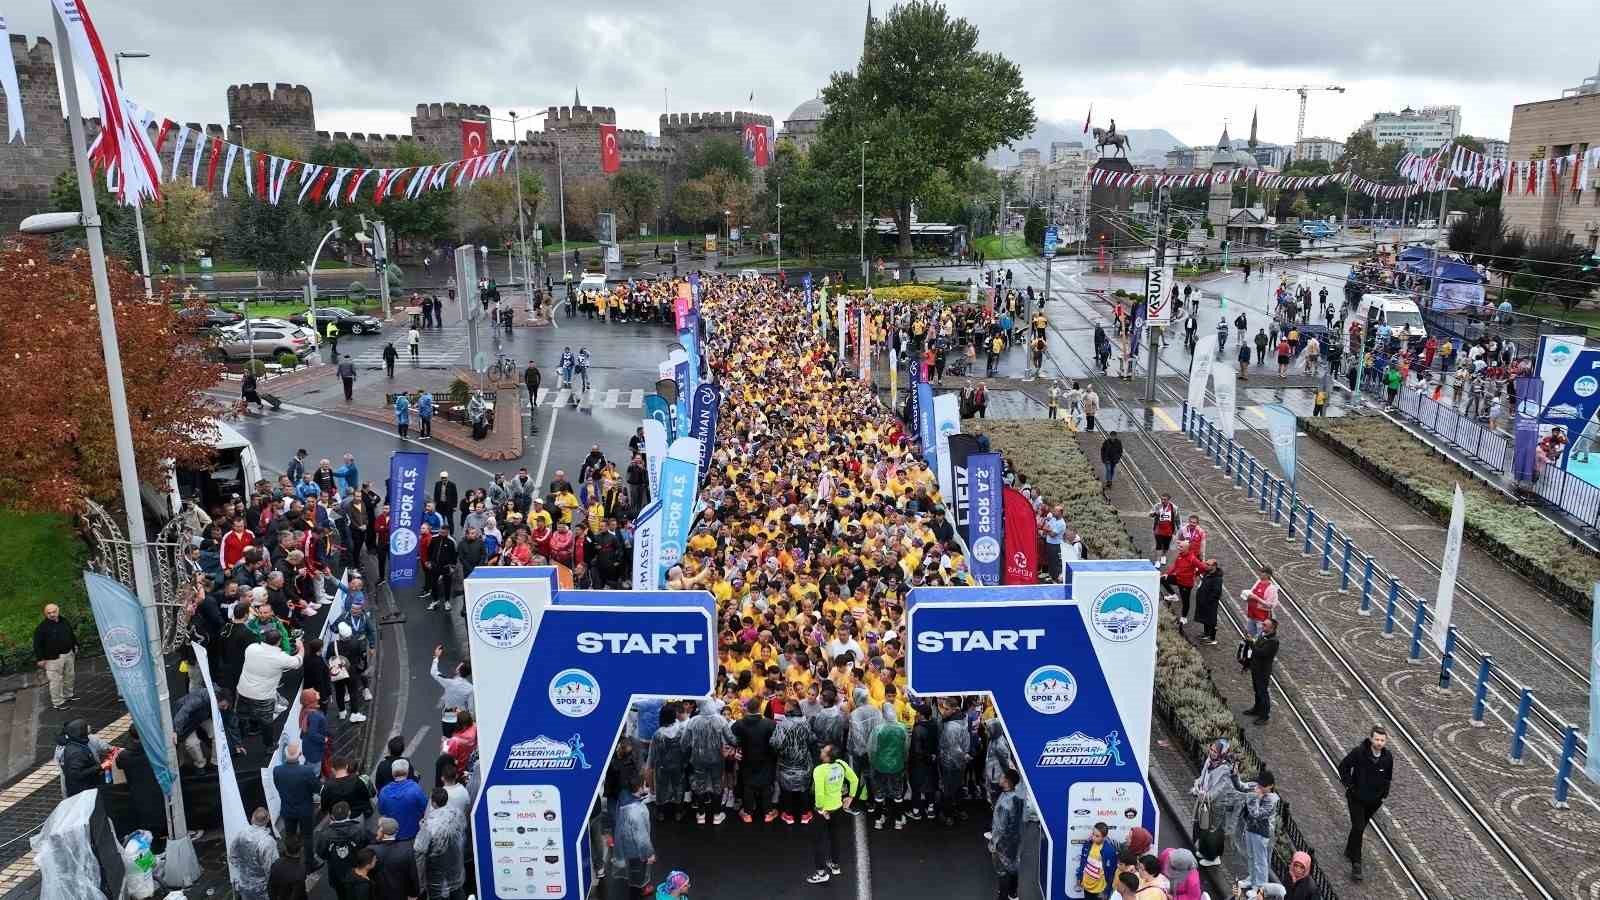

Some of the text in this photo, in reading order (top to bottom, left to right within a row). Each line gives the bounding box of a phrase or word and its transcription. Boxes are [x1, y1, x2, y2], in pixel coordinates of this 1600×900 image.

[1149, 269, 1161, 318] KARUM
[698, 409, 710, 467] DEDEMAN
[400, 467, 418, 527] SPOR A.Ş.
[668, 502, 683, 537] SPOR
[576, 632, 702, 654] START
[917, 628, 1045, 653] START
[508, 758, 573, 769] MARATONU
[1041, 755, 1107, 765] MARATONU
